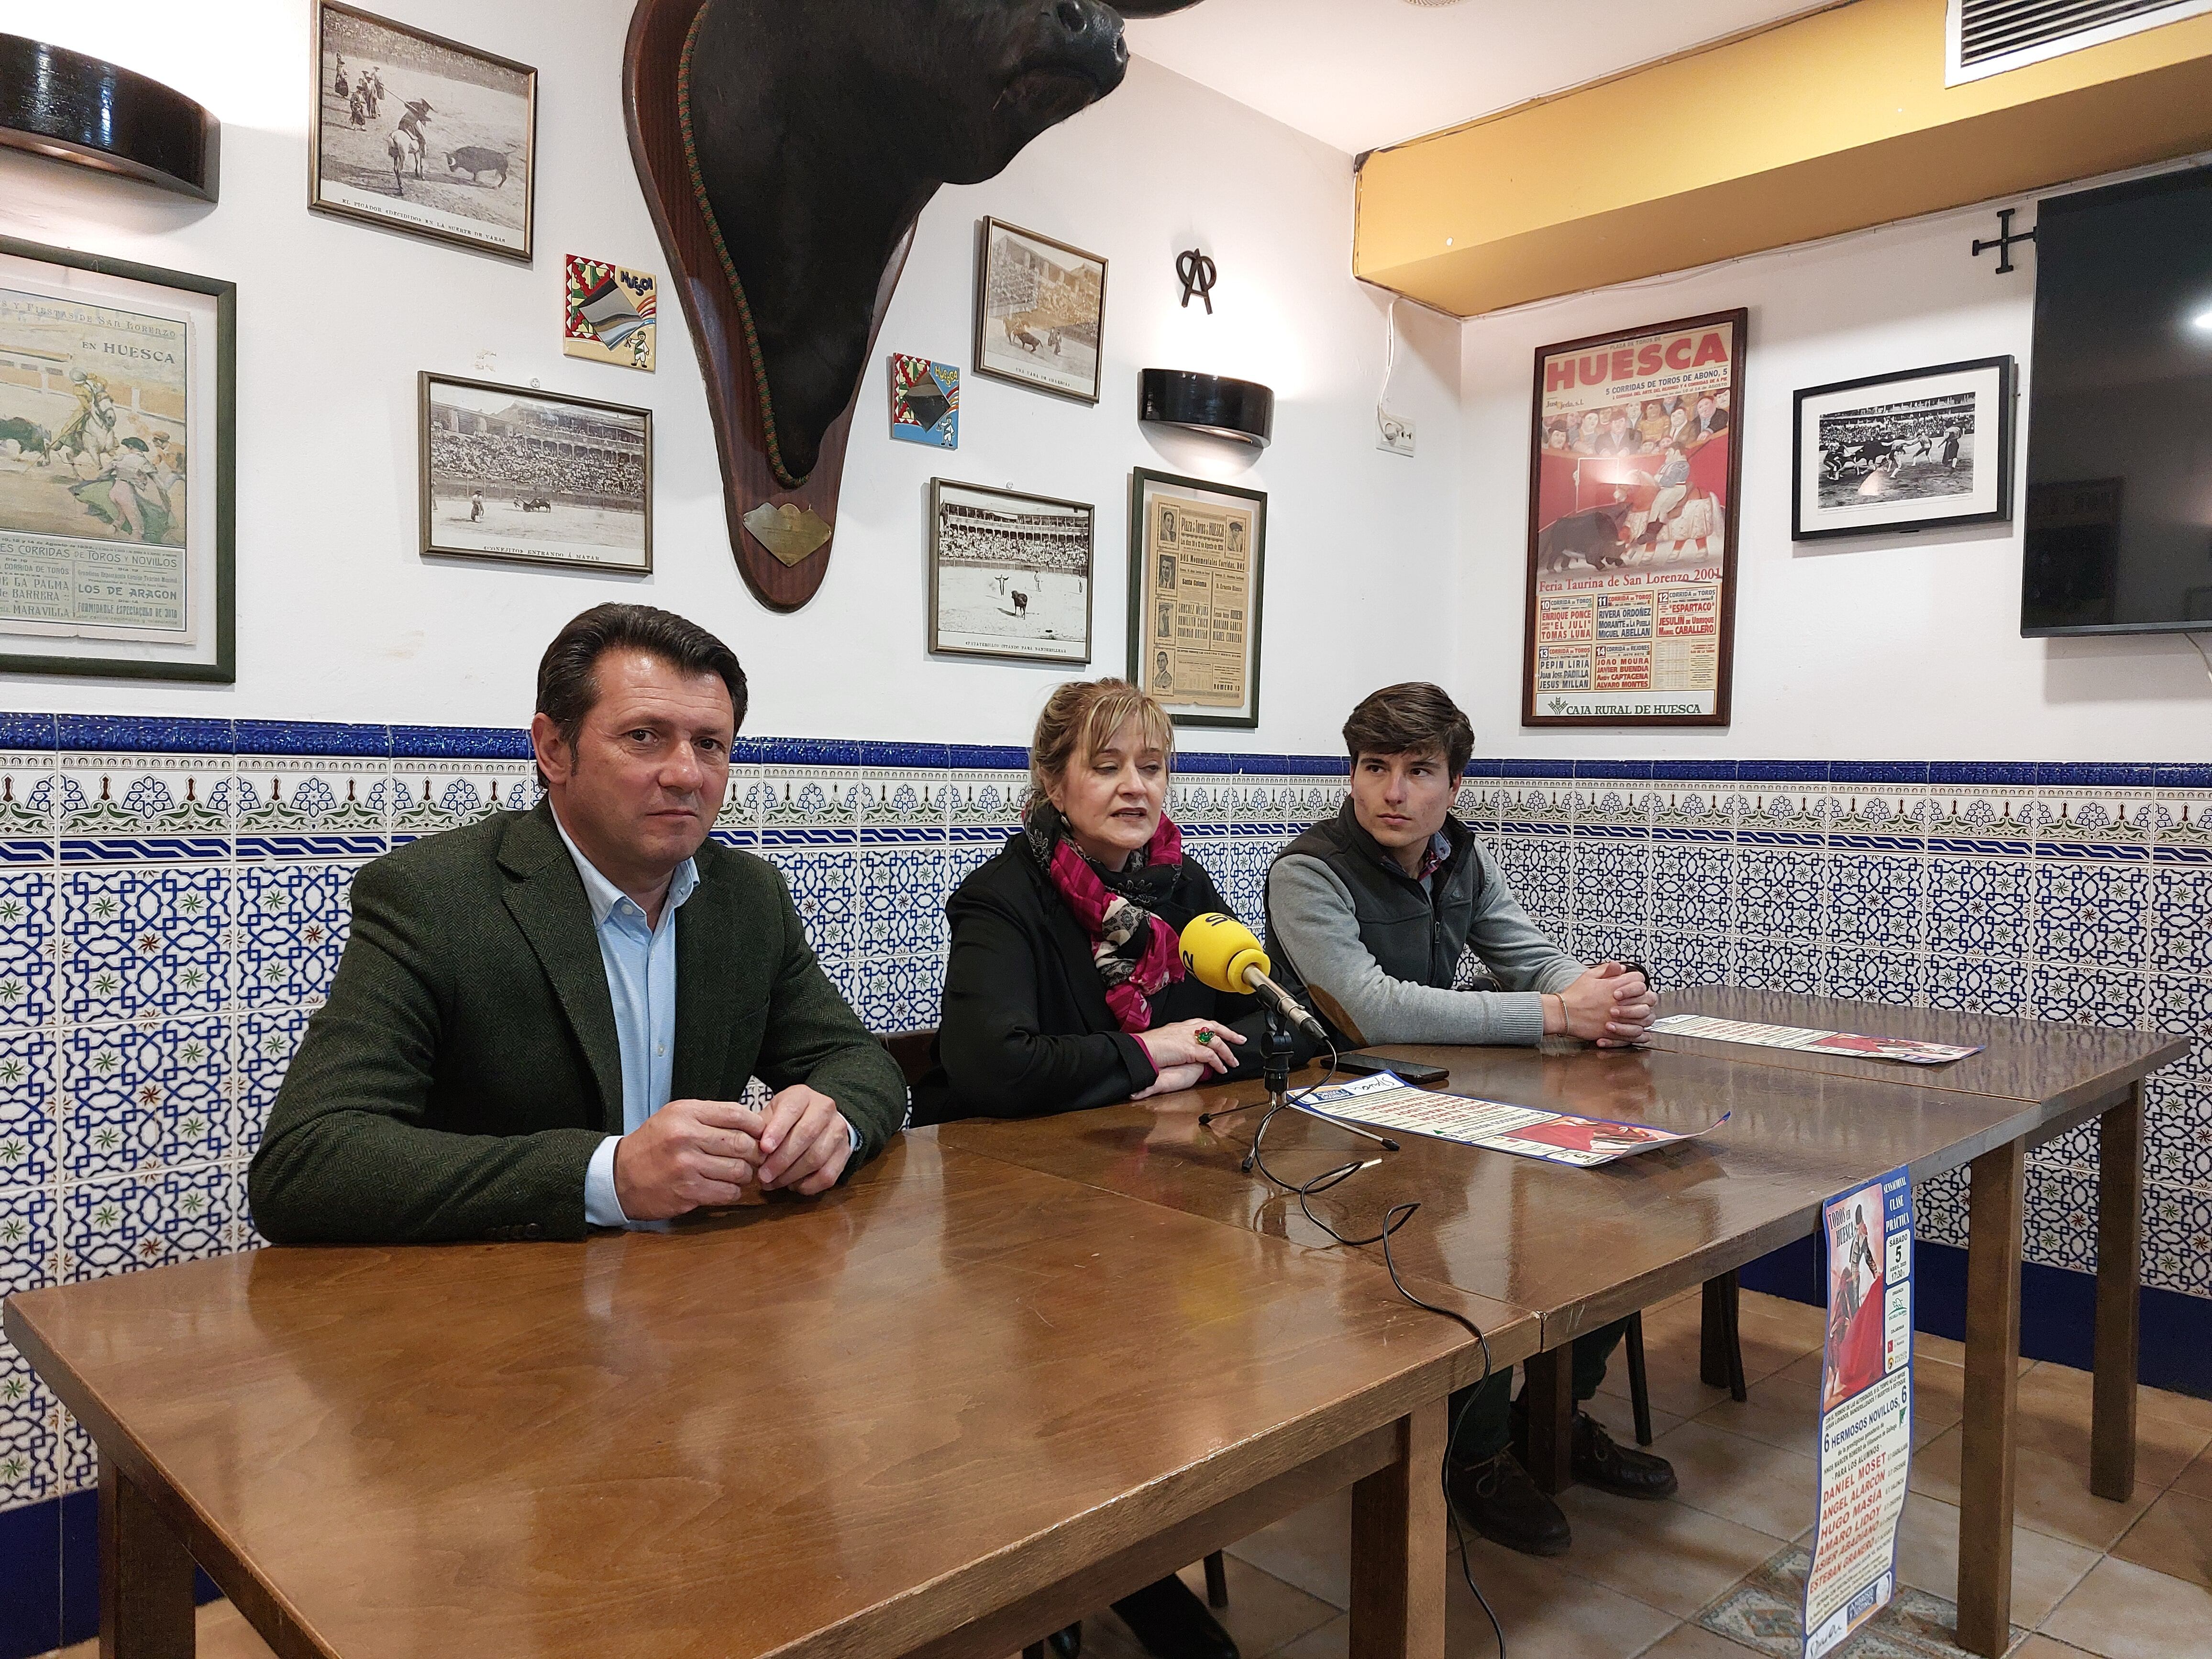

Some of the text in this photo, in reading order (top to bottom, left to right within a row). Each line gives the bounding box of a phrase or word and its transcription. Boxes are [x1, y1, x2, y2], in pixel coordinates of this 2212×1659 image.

[354, 201, 383, 212] PICADOR
[448, 225, 472, 235] SUERTE
[620, 270, 654, 297] HUESCA
[103, 342, 176, 365] HUESCA
[1546, 332, 1729, 392] HUESCA
[934, 365, 958, 387] HUESCA
[1612, 382, 1645, 394] CORRIDAS
[1659, 376, 1681, 386] TOROS
[1683, 374, 1692, 382] DE
[1694, 369, 1721, 380] ABONO,
[18, 545, 71, 558] CORRIDAS
[87, 550, 121, 563] TOROS
[132, 555, 177, 568] NOVILLOS
[1180, 553, 1189, 562] DOS
[1237, 562, 1245, 571] DOS
[1539, 580, 1563, 592] Feria
[1565, 577, 1604, 590] Taurina
[1607, 575, 1620, 587] de
[1623, 574, 1642, 586] San
[1646, 572, 1690, 584] Lorenzo
[77, 584, 100, 594] LOS
[107, 586, 123, 596] DE
[129, 588, 177, 600] ARAGON
[1658, 593, 1668, 602] 12
[1541, 601, 1550, 610] 10
[1598, 597, 1606, 607] 11
[1542, 609, 1592, 621] ENRIQUE PONCE
[1599, 607, 1651, 619] RIVERA ORDOÑEZ
[1541, 629, 1591, 640] TOMAS LUNA
[1621, 627, 1650, 637] ABELLAN
[1675, 624, 1714, 635] CABALLERO
[1539, 649, 1548, 658] 13
[1596, 647, 1605, 656] 14
[1540, 660, 1589, 669] PEPIN LIRIA
[1563, 669, 1589, 678] PADILLA
[1539, 679, 1589, 689] JESUS MILLAN
[1566, 704, 1702, 715] CAJA RURAL DE HUESCA
[1890, 1194, 1904, 1212] CLASE
[1828, 1207, 1851, 1230] TOROS en
[1885, 1212, 1910, 1233] PRÁCTICA
[1836, 1221, 1854, 1248] HUESCA
[1889, 1233, 1908, 1248] SÁBADO
[1895, 1245, 1902, 1263] 5
[1890, 1264, 1899, 1272] ABRIL
[1891, 1269, 1902, 1282] 17:30
[1824, 1385, 1907, 1453] 6 HERMOSOS NOVILLOS, 6
[1834, 1443, 1880, 1481] PARA LOS ALUMNOS
[1823, 1451, 1887, 1504] DANIEL MOSET
[1821, 1495, 1848, 1524] ANGEL
[1817, 1504, 1882, 1559] AMARO LIDOY
[1821, 1511, 1850, 1541] HUGO
